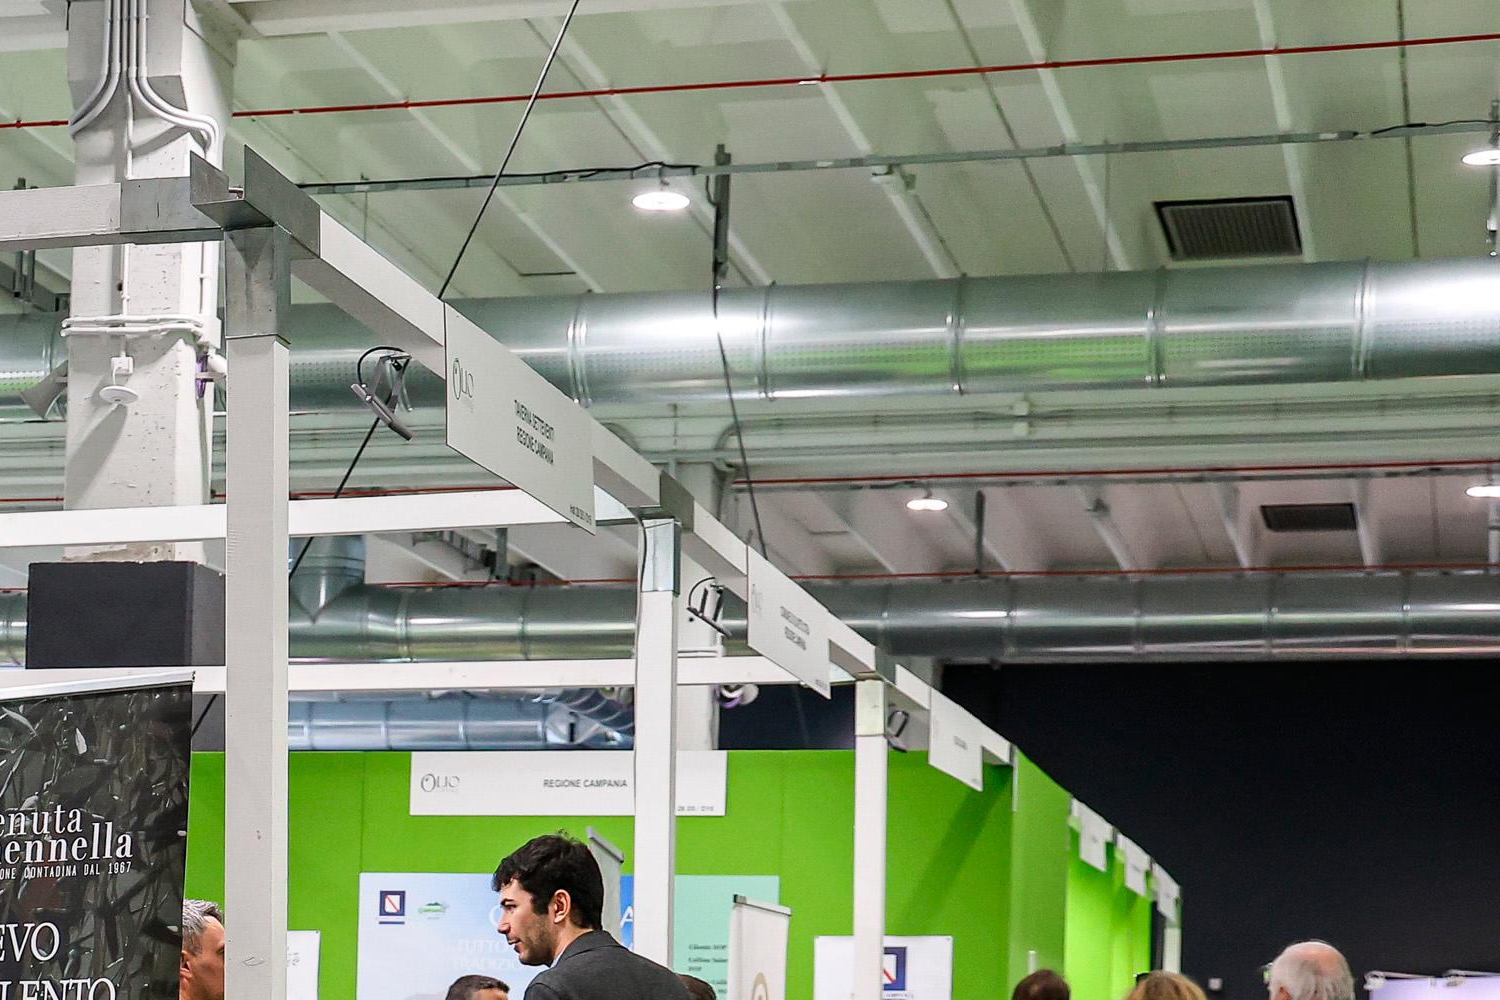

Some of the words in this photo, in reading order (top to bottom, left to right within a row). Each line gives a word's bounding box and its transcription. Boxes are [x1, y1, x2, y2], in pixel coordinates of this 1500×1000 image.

[543, 779, 581, 788] REGIONE
[583, 779, 627, 788] CAMPANIA
[23, 865, 77, 880] CONTADINA
[84, 863, 100, 877] DAL
[108, 861, 132, 874] 1967
